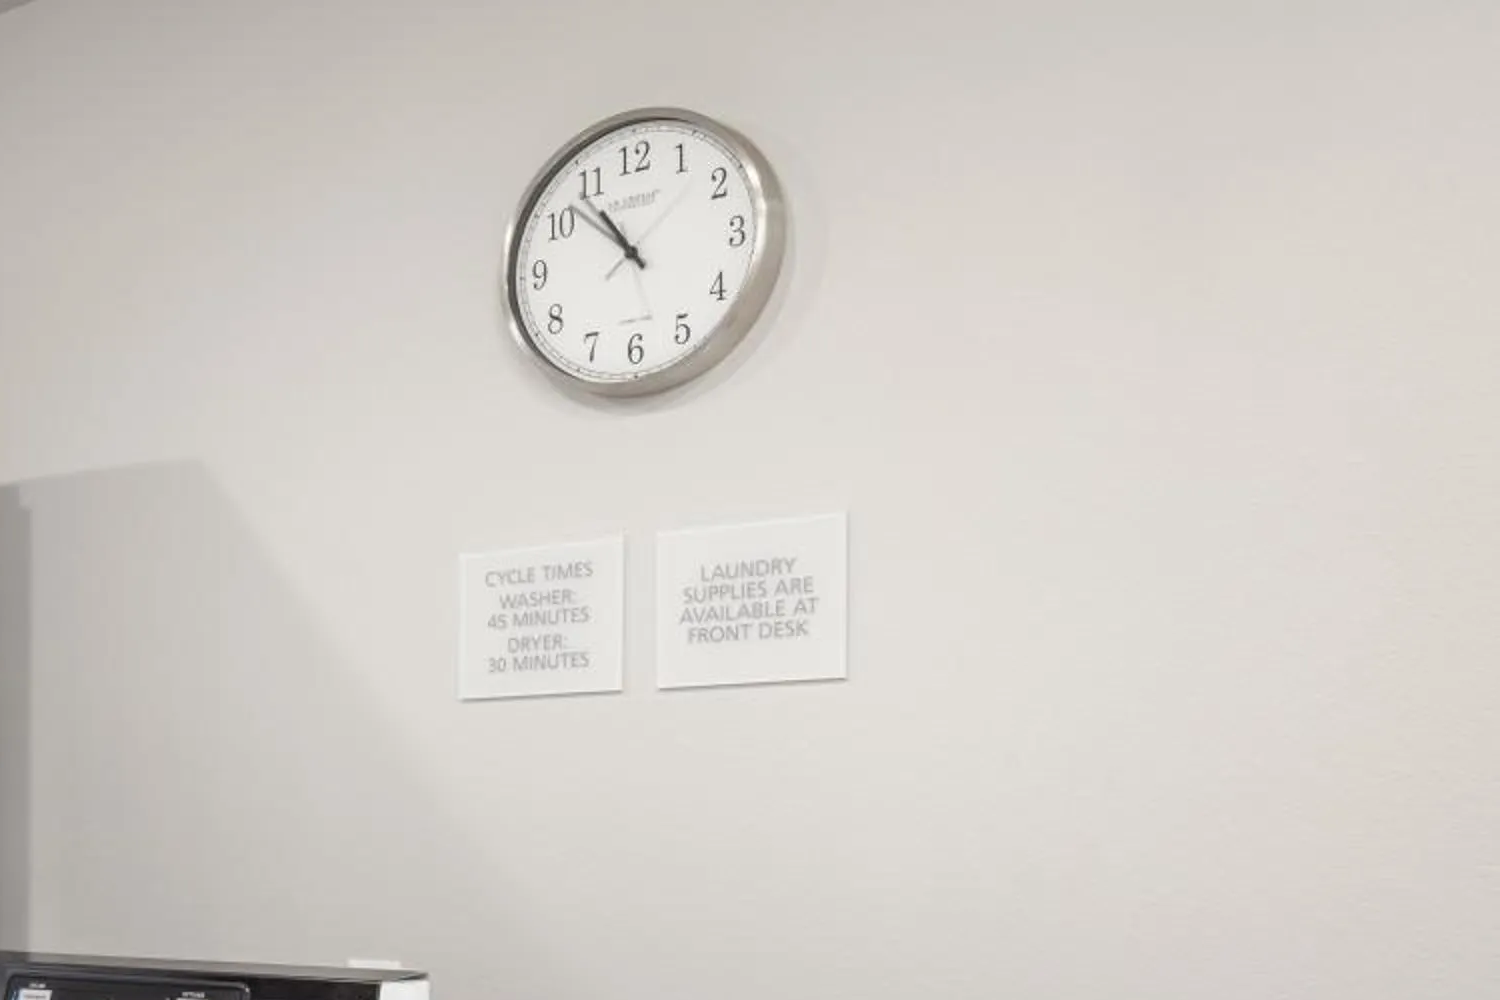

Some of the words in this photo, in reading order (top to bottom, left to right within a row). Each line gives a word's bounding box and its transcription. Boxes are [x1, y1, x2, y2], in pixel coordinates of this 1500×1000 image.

[618, 141, 651, 176] 12
[675, 143, 688, 174] 1
[579, 167, 604, 200] 11
[710, 167, 728, 200] 2
[548, 207, 575, 242] 10
[729, 215, 745, 247] 3
[532, 260, 548, 291] 9
[709, 271, 727, 301] 4
[547, 303, 564, 334] 8
[675, 313, 691, 344] 5
[584, 331, 600, 362] 7
[627, 333, 644, 364] 6
[485, 567, 535, 588] CYCLE
[541, 561, 594, 582] TIMES
[700, 558, 797, 582] LAUNDRY
[499, 588, 576, 609] WASHER:
[682, 581, 767, 604] SUPPLIES
[775, 576, 814, 595] ARE
[487, 613, 507, 629] 45
[512, 607, 590, 628] MINUTES
[679, 600, 786, 625] AVAILABLE
[794, 598, 818, 615] AT
[507, 634, 567, 654] DRYER:
[687, 624, 751, 645] FRONT
[759, 620, 809, 640] DESK
[488, 657, 507, 673] 30
[512, 652, 590, 672] MINUTES
